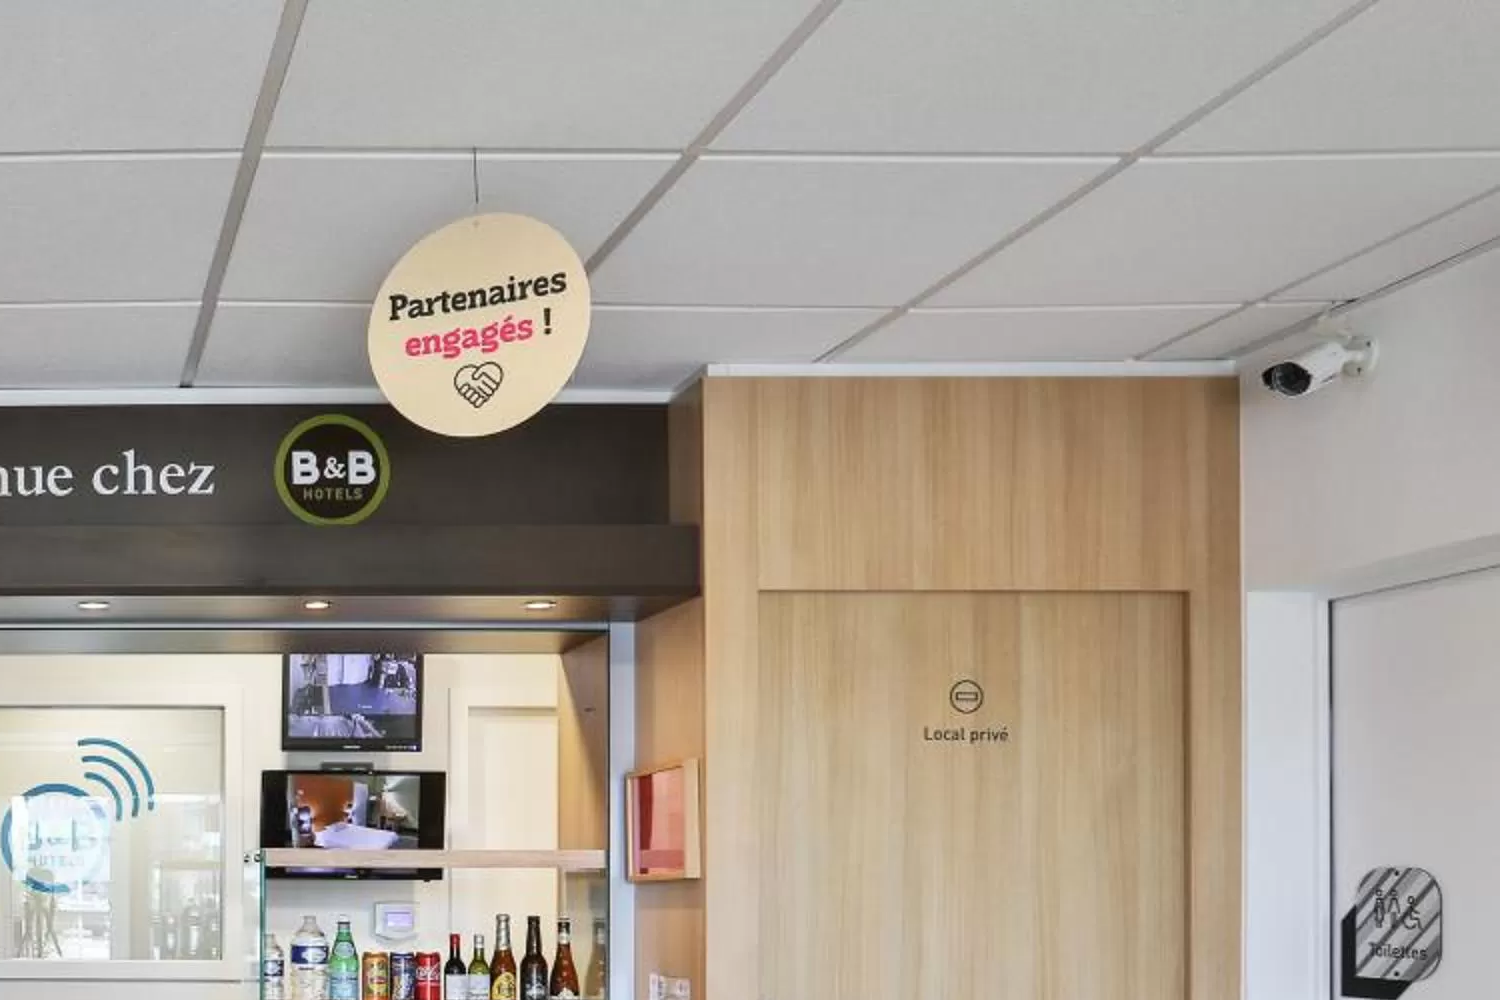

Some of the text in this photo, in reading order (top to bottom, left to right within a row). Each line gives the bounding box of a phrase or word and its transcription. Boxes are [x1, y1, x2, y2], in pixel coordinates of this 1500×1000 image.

[388, 271, 568, 321] Partenaires
[404, 307, 553, 359] engagés !
[92, 448, 216, 498] chez
[291, 450, 377, 485] B&B
[303, 487, 364, 500] HOTELS
[923, 726, 1009, 744] Local privé
